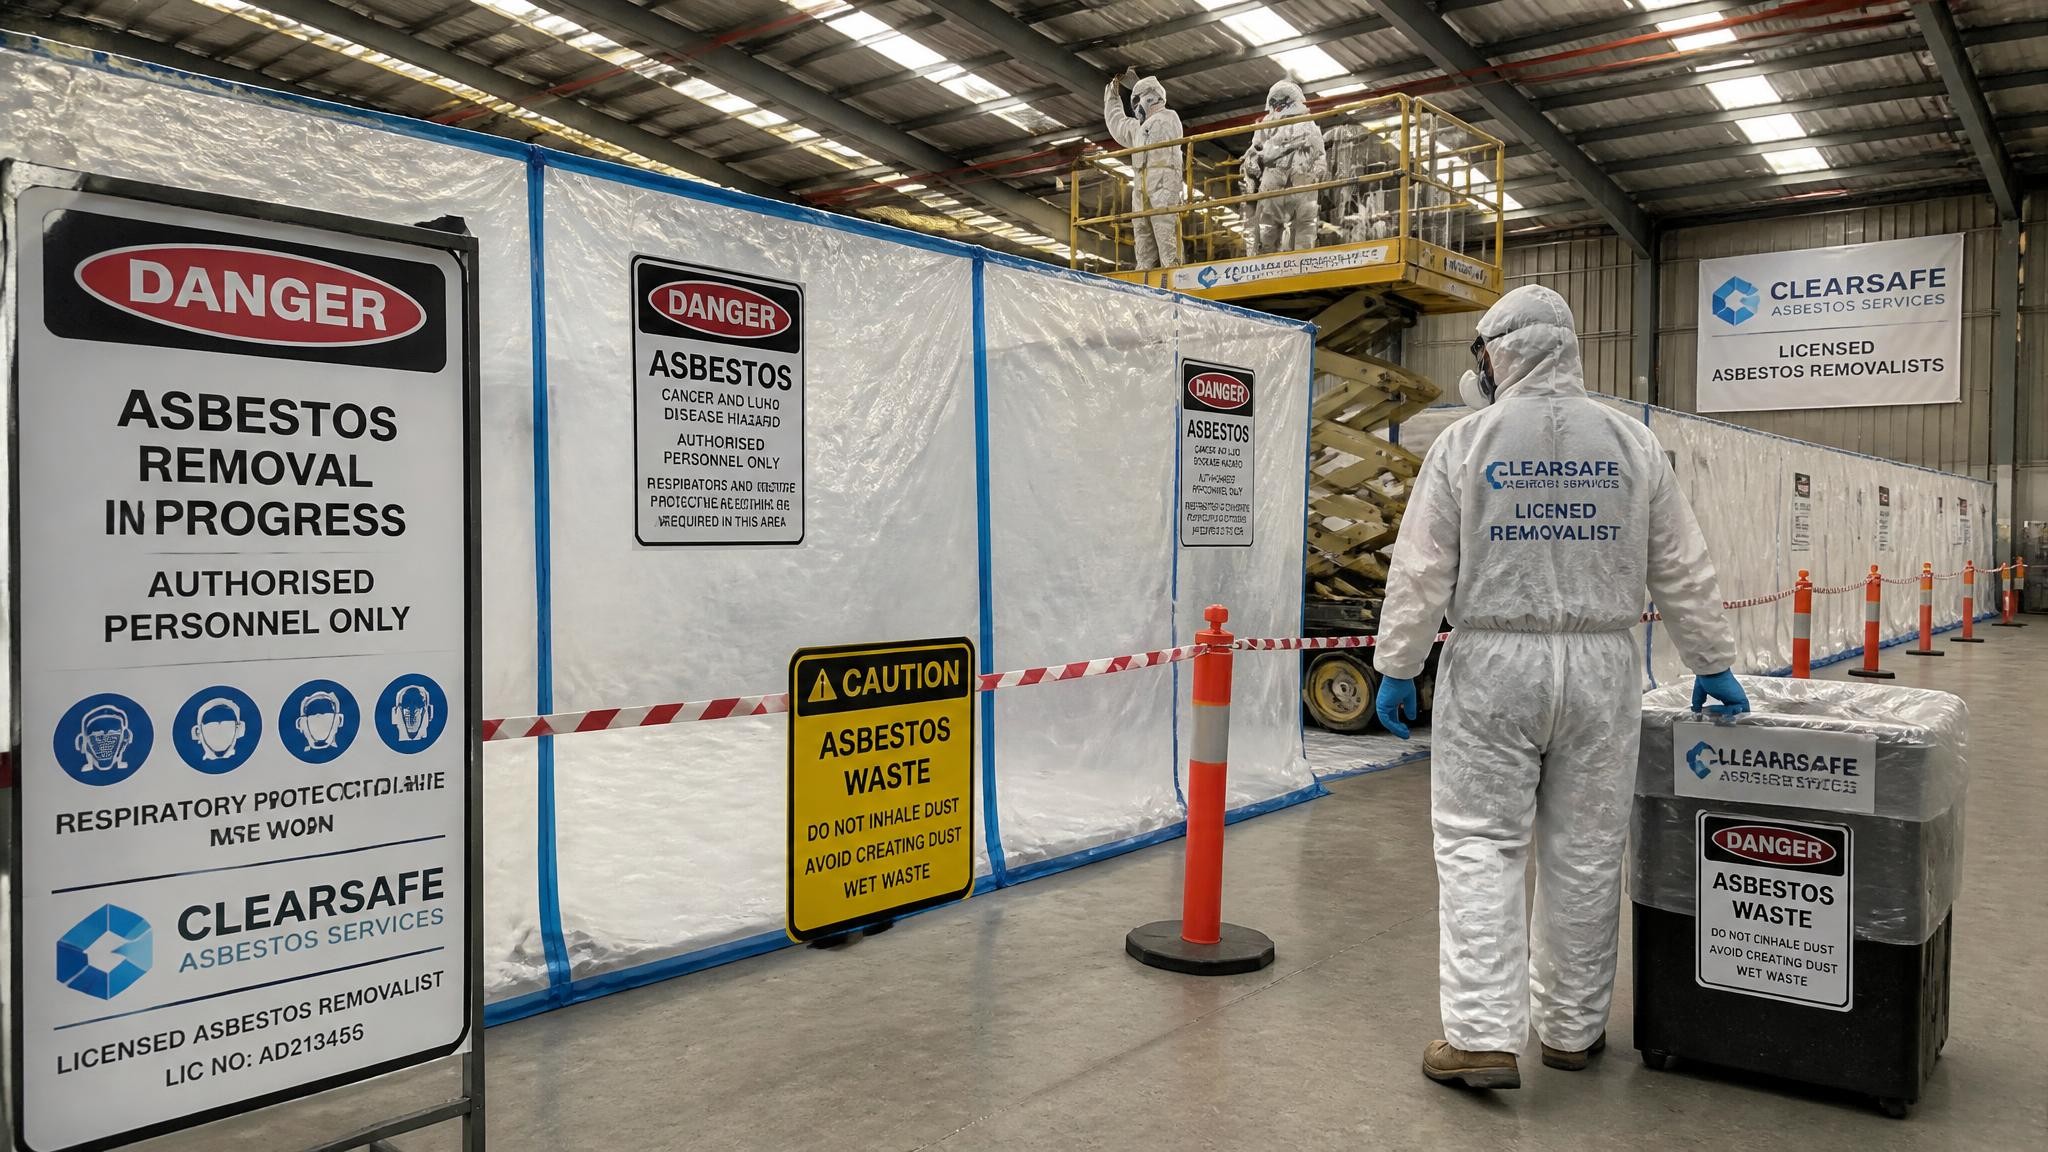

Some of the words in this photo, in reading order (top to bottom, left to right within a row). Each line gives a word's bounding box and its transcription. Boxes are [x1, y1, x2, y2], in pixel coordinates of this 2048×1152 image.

[129, 258, 388, 332] DANGER
[1770, 267, 1946, 301] CLEARSAFE
[668, 288, 776, 330] DANGER
[1771, 301, 1856, 317] ASBESTOS
[1861, 293, 1945, 310] SERVICES
[1779, 340, 1875, 358] LICENSED
[649, 350, 792, 391] ASBESTOS
[1712, 365, 1804, 382] ASBESTOS
[1810, 358, 1945, 378] REMOVALISTS
[662, 388, 714, 405] CANCER
[718, 393, 745, 407] AND
[1196, 379, 1245, 402] DANGER
[117, 389, 398, 442] ASBESTOS
[664, 407, 724, 424] DISEASE
[1187, 419, 1249, 443] ASBESTOS
[677, 433, 765, 451] AUTHORISED
[139, 445, 373, 488] REMOVAL
[664, 451, 743, 468] PERSONNEL
[747, 456, 780, 469] ONLY
[730, 480, 753, 492] AND
[105, 499, 145, 536] IN
[156, 500, 406, 537] PROGRESS
[722, 516, 732, 527] IN
[735, 516, 758, 527] THIS
[760, 516, 786, 527] AREA
[1490, 525, 1621, 541] REMOVALIST
[147, 569, 375, 598] AUTHORISED
[104, 610, 319, 643] PERSONNEL
[329, 606, 410, 633] ONLY
[842, 660, 960, 697] CAUTION
[819, 716, 950, 760] ASBESTOS
[844, 758, 930, 796] WASTE
[56, 794, 247, 835] RESPIRATORY
[808, 822, 830, 842] DO
[834, 815, 864, 837] NOT
[869, 804, 920, 829] INHALE
[924, 797, 960, 818] DUST
[805, 850, 851, 875] AVOID
[856, 834, 925, 863] CREATING
[928, 826, 962, 846] DUST
[1727, 831, 1822, 860] DANGER
[844, 875, 877, 899] WET
[881, 863, 930, 890] WASTE
[1712, 872, 1834, 905] ASBESTOS
[177, 867, 444, 942] CLEARSAFE
[1732, 900, 1812, 929] WASTE
[178, 927, 319, 974] ASBESTOS
[327, 908, 444, 945] SERVICES
[1711, 927, 1726, 938] DO
[1729, 930, 1751, 942] NOT
[1804, 942, 1834, 955] DUST
[1709, 945, 1743, 958] AVOID
[1746, 950, 1802, 968] CREATING
[1806, 960, 1838, 974] DUST
[1737, 965, 1762, 979] WET
[1766, 970, 1808, 986] WASTE
[57, 1029, 185, 1075] LICENSED
[193, 1002, 313, 1045] ASBESTOS
[318, 971, 444, 1016] REMOVALIST
[165, 1061, 204, 1087] LIC
[212, 1052, 252, 1076] NO:
